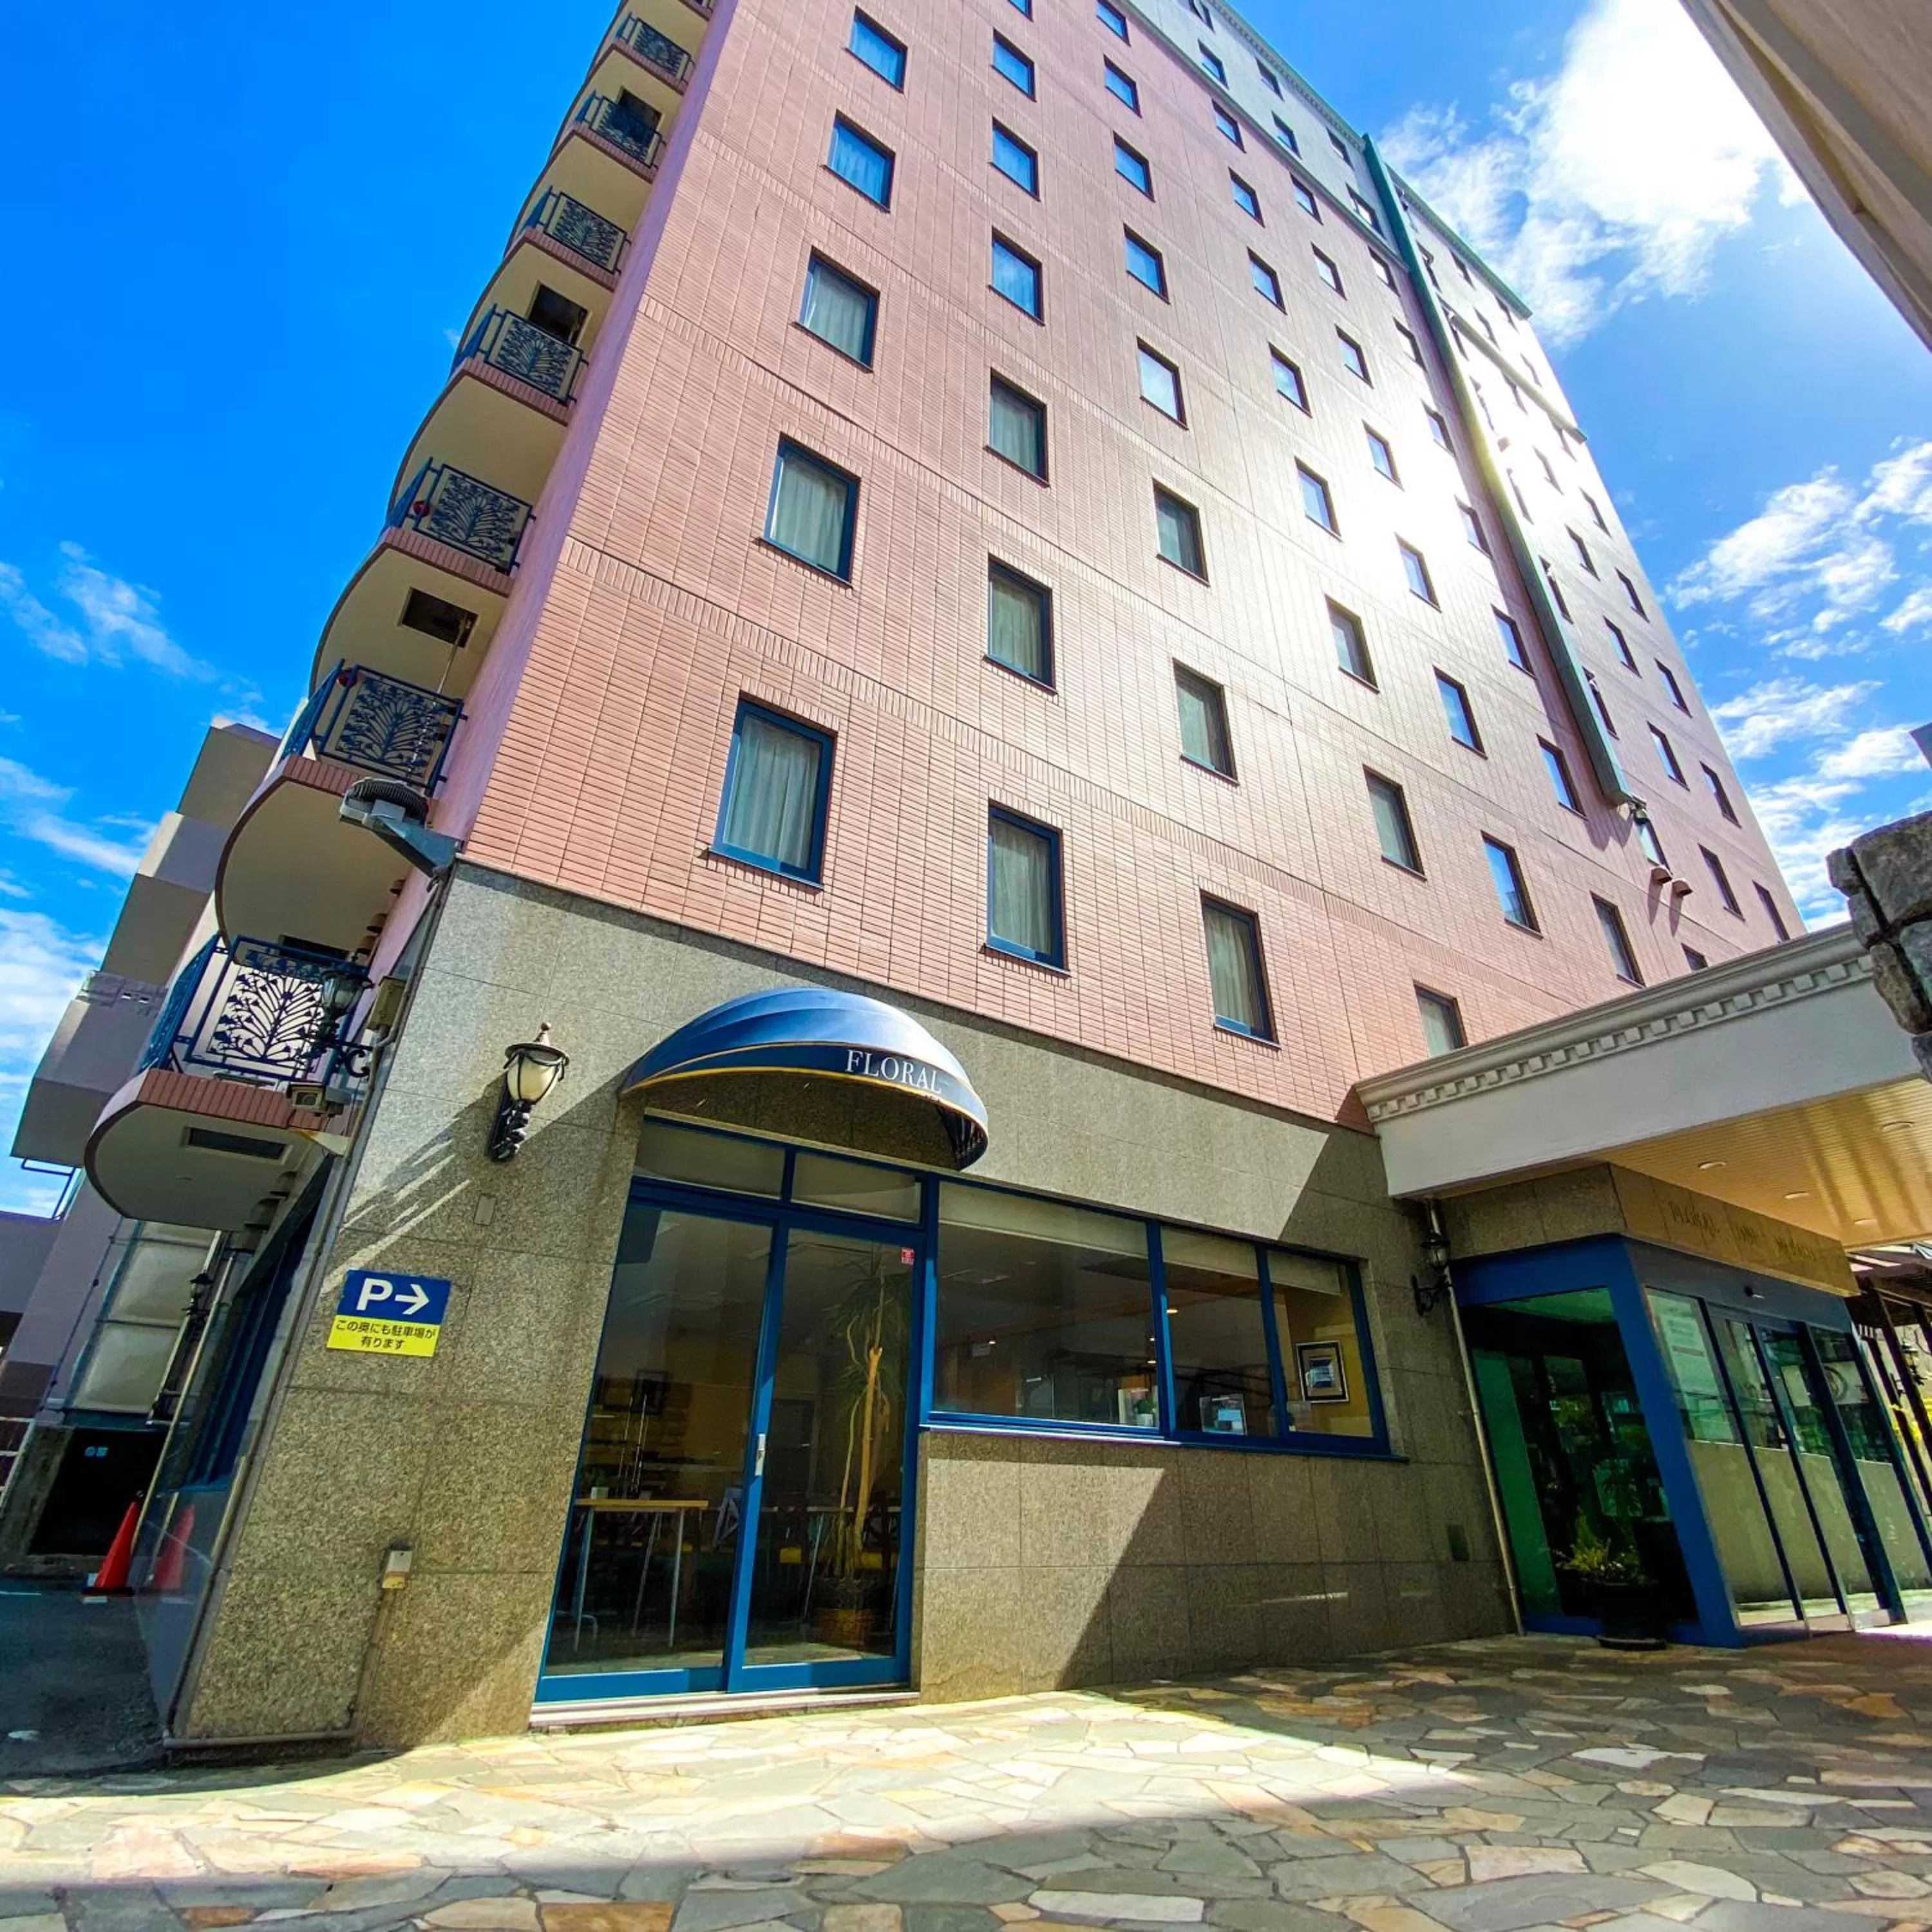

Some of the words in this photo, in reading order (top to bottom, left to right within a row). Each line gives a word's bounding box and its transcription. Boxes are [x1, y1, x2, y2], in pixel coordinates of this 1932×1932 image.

[845, 1049, 942, 1094] FLORAL
[355, 1277, 393, 1311] P
[336, 1320, 436, 1339] この奥にも駐車場が
[361, 1336, 406, 1350] 有ります
